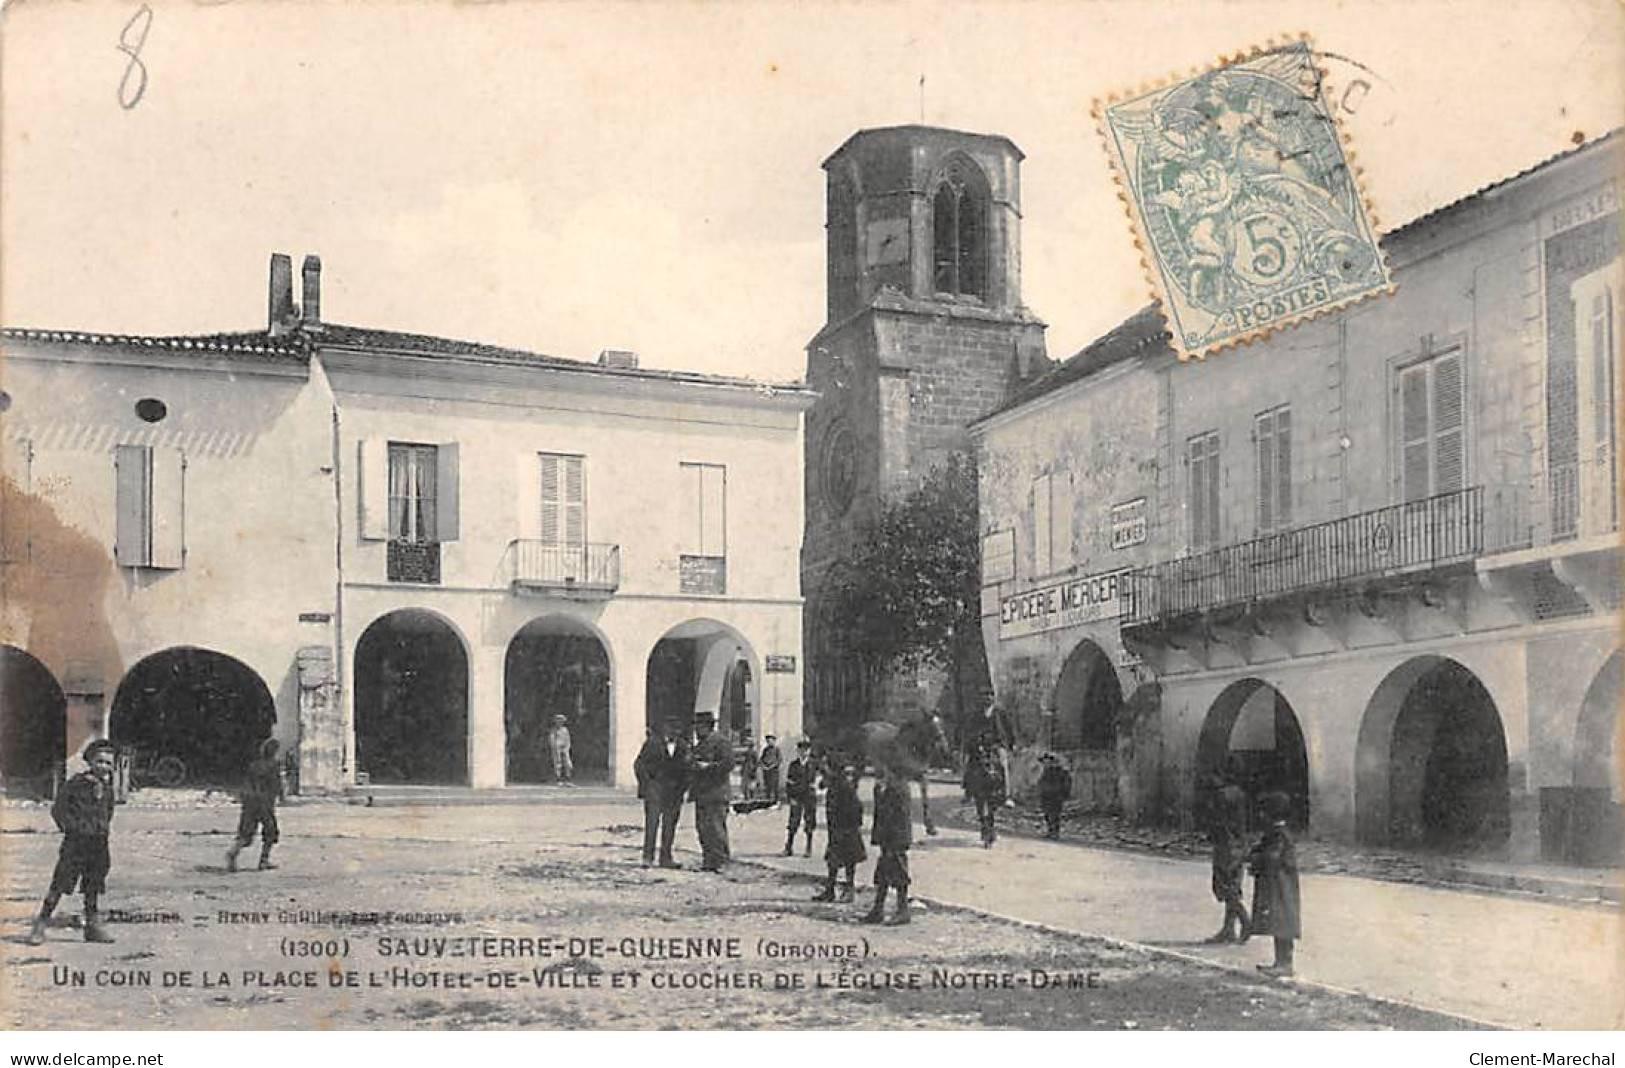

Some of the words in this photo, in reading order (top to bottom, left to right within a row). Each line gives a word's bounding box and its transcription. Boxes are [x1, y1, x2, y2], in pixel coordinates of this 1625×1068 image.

[117, 3, 154, 110] 8
[1246, 216, 1286, 277] 5
[1237, 281, 1329, 327] POSTES
[1002, 588, 1058, 625] EPICERIE
